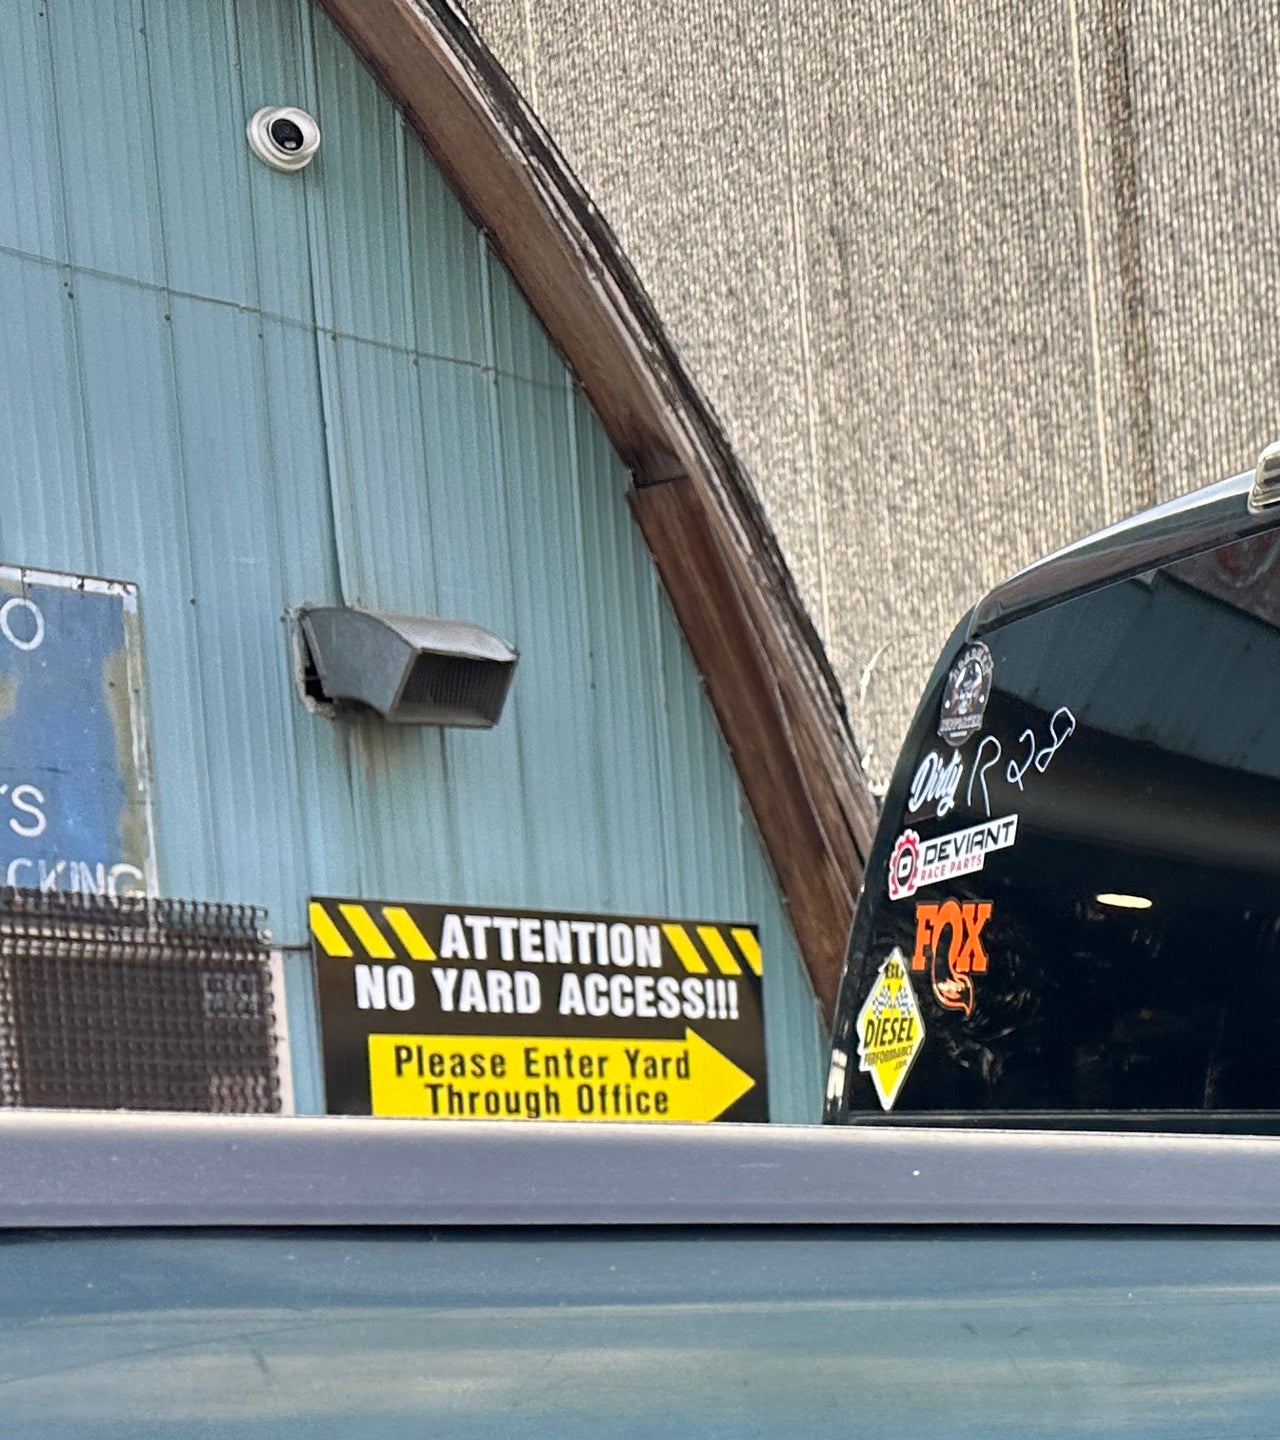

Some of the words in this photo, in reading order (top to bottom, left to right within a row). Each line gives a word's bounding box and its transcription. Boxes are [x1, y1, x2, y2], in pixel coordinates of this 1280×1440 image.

[908, 748, 963, 816] Dirty
[923, 820, 1015, 867] DEVIANT
[921, 863, 946, 882] RACE
[951, 854, 983, 874] PARTS
[440, 913, 663, 968] ATTENTION
[911, 899, 992, 1016] FOX
[355, 964, 414, 1011] NO
[431, 967, 541, 1014] YARD
[558, 972, 739, 1020] ACCESS!!!
[864, 1017, 914, 1049] DIESEL
[395, 1045, 505, 1078] Please
[523, 1047, 606, 1079] Enter
[624, 1048, 690, 1080] Yard
[424, 1083, 561, 1118] Through
[576, 1086, 668, 1114] Office
